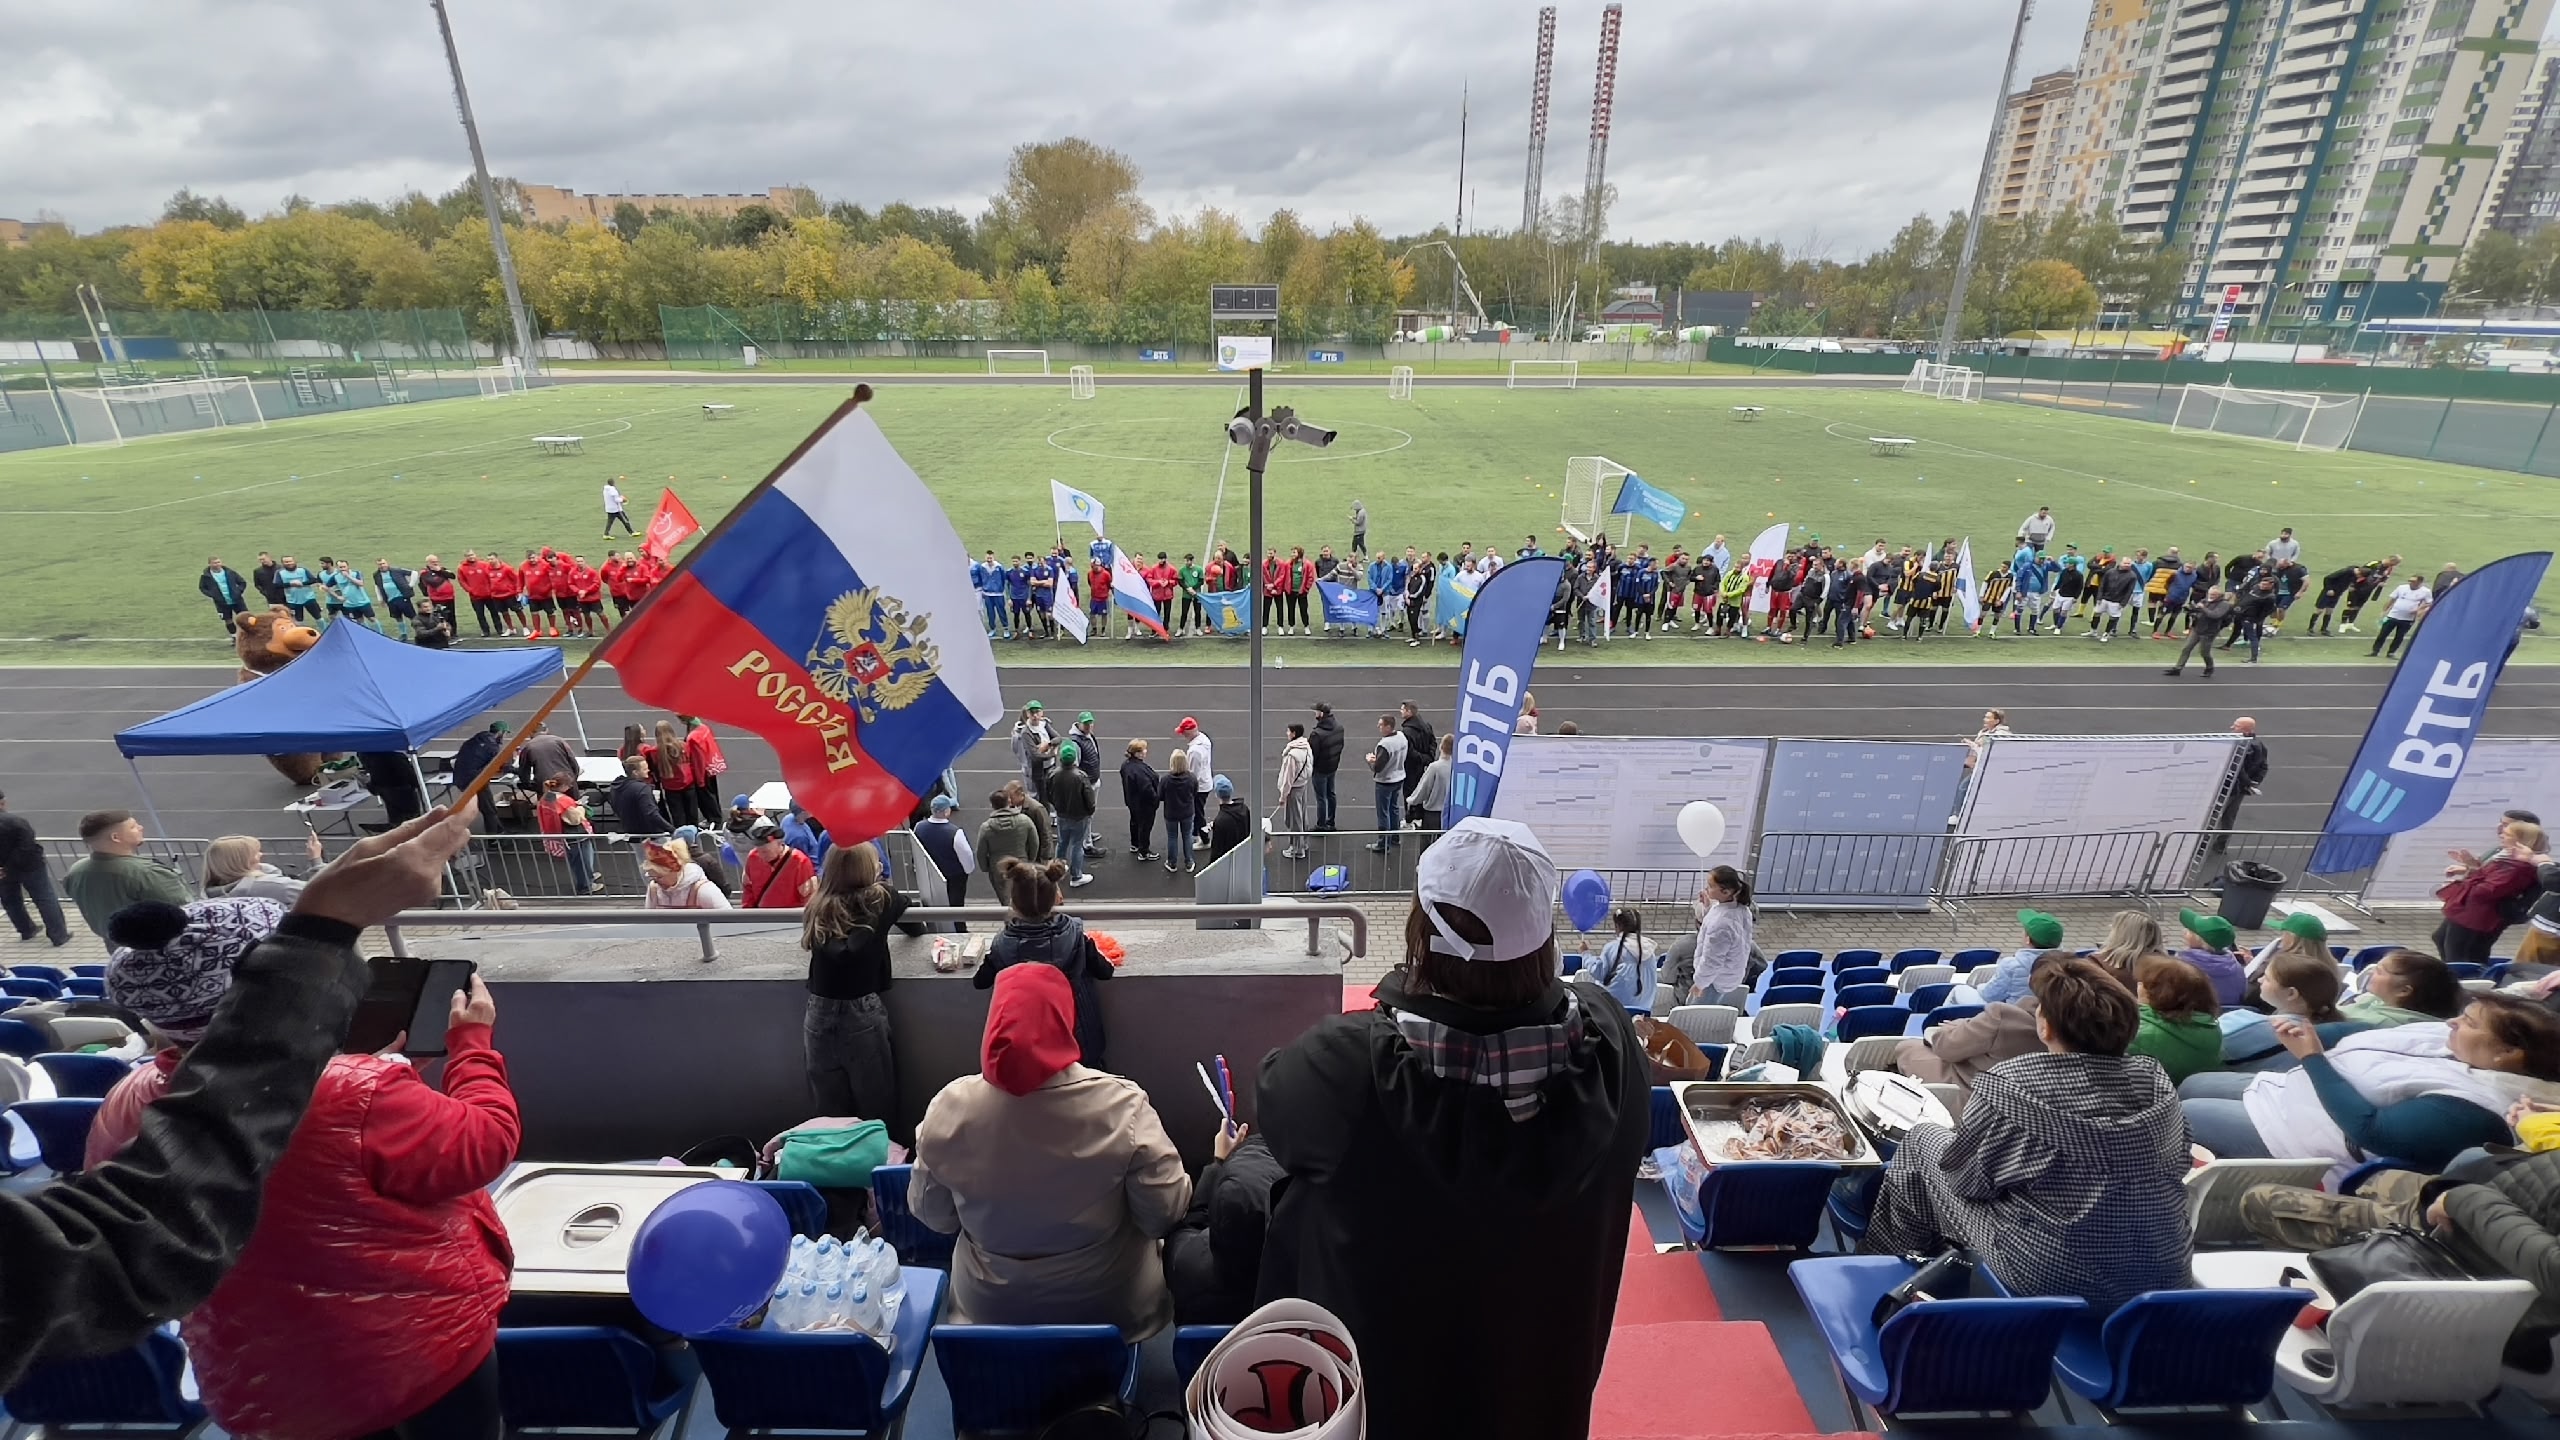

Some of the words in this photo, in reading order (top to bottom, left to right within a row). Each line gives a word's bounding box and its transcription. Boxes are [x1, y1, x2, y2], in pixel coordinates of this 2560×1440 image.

[1153, 351, 1169, 360] ВТБ
[1321, 353, 1338, 362] ВТБ
[726, 650, 858, 773] РОССИЯ
[1457, 658, 1518, 778] ВТБ
[2388, 659, 2488, 778] ВТБ
